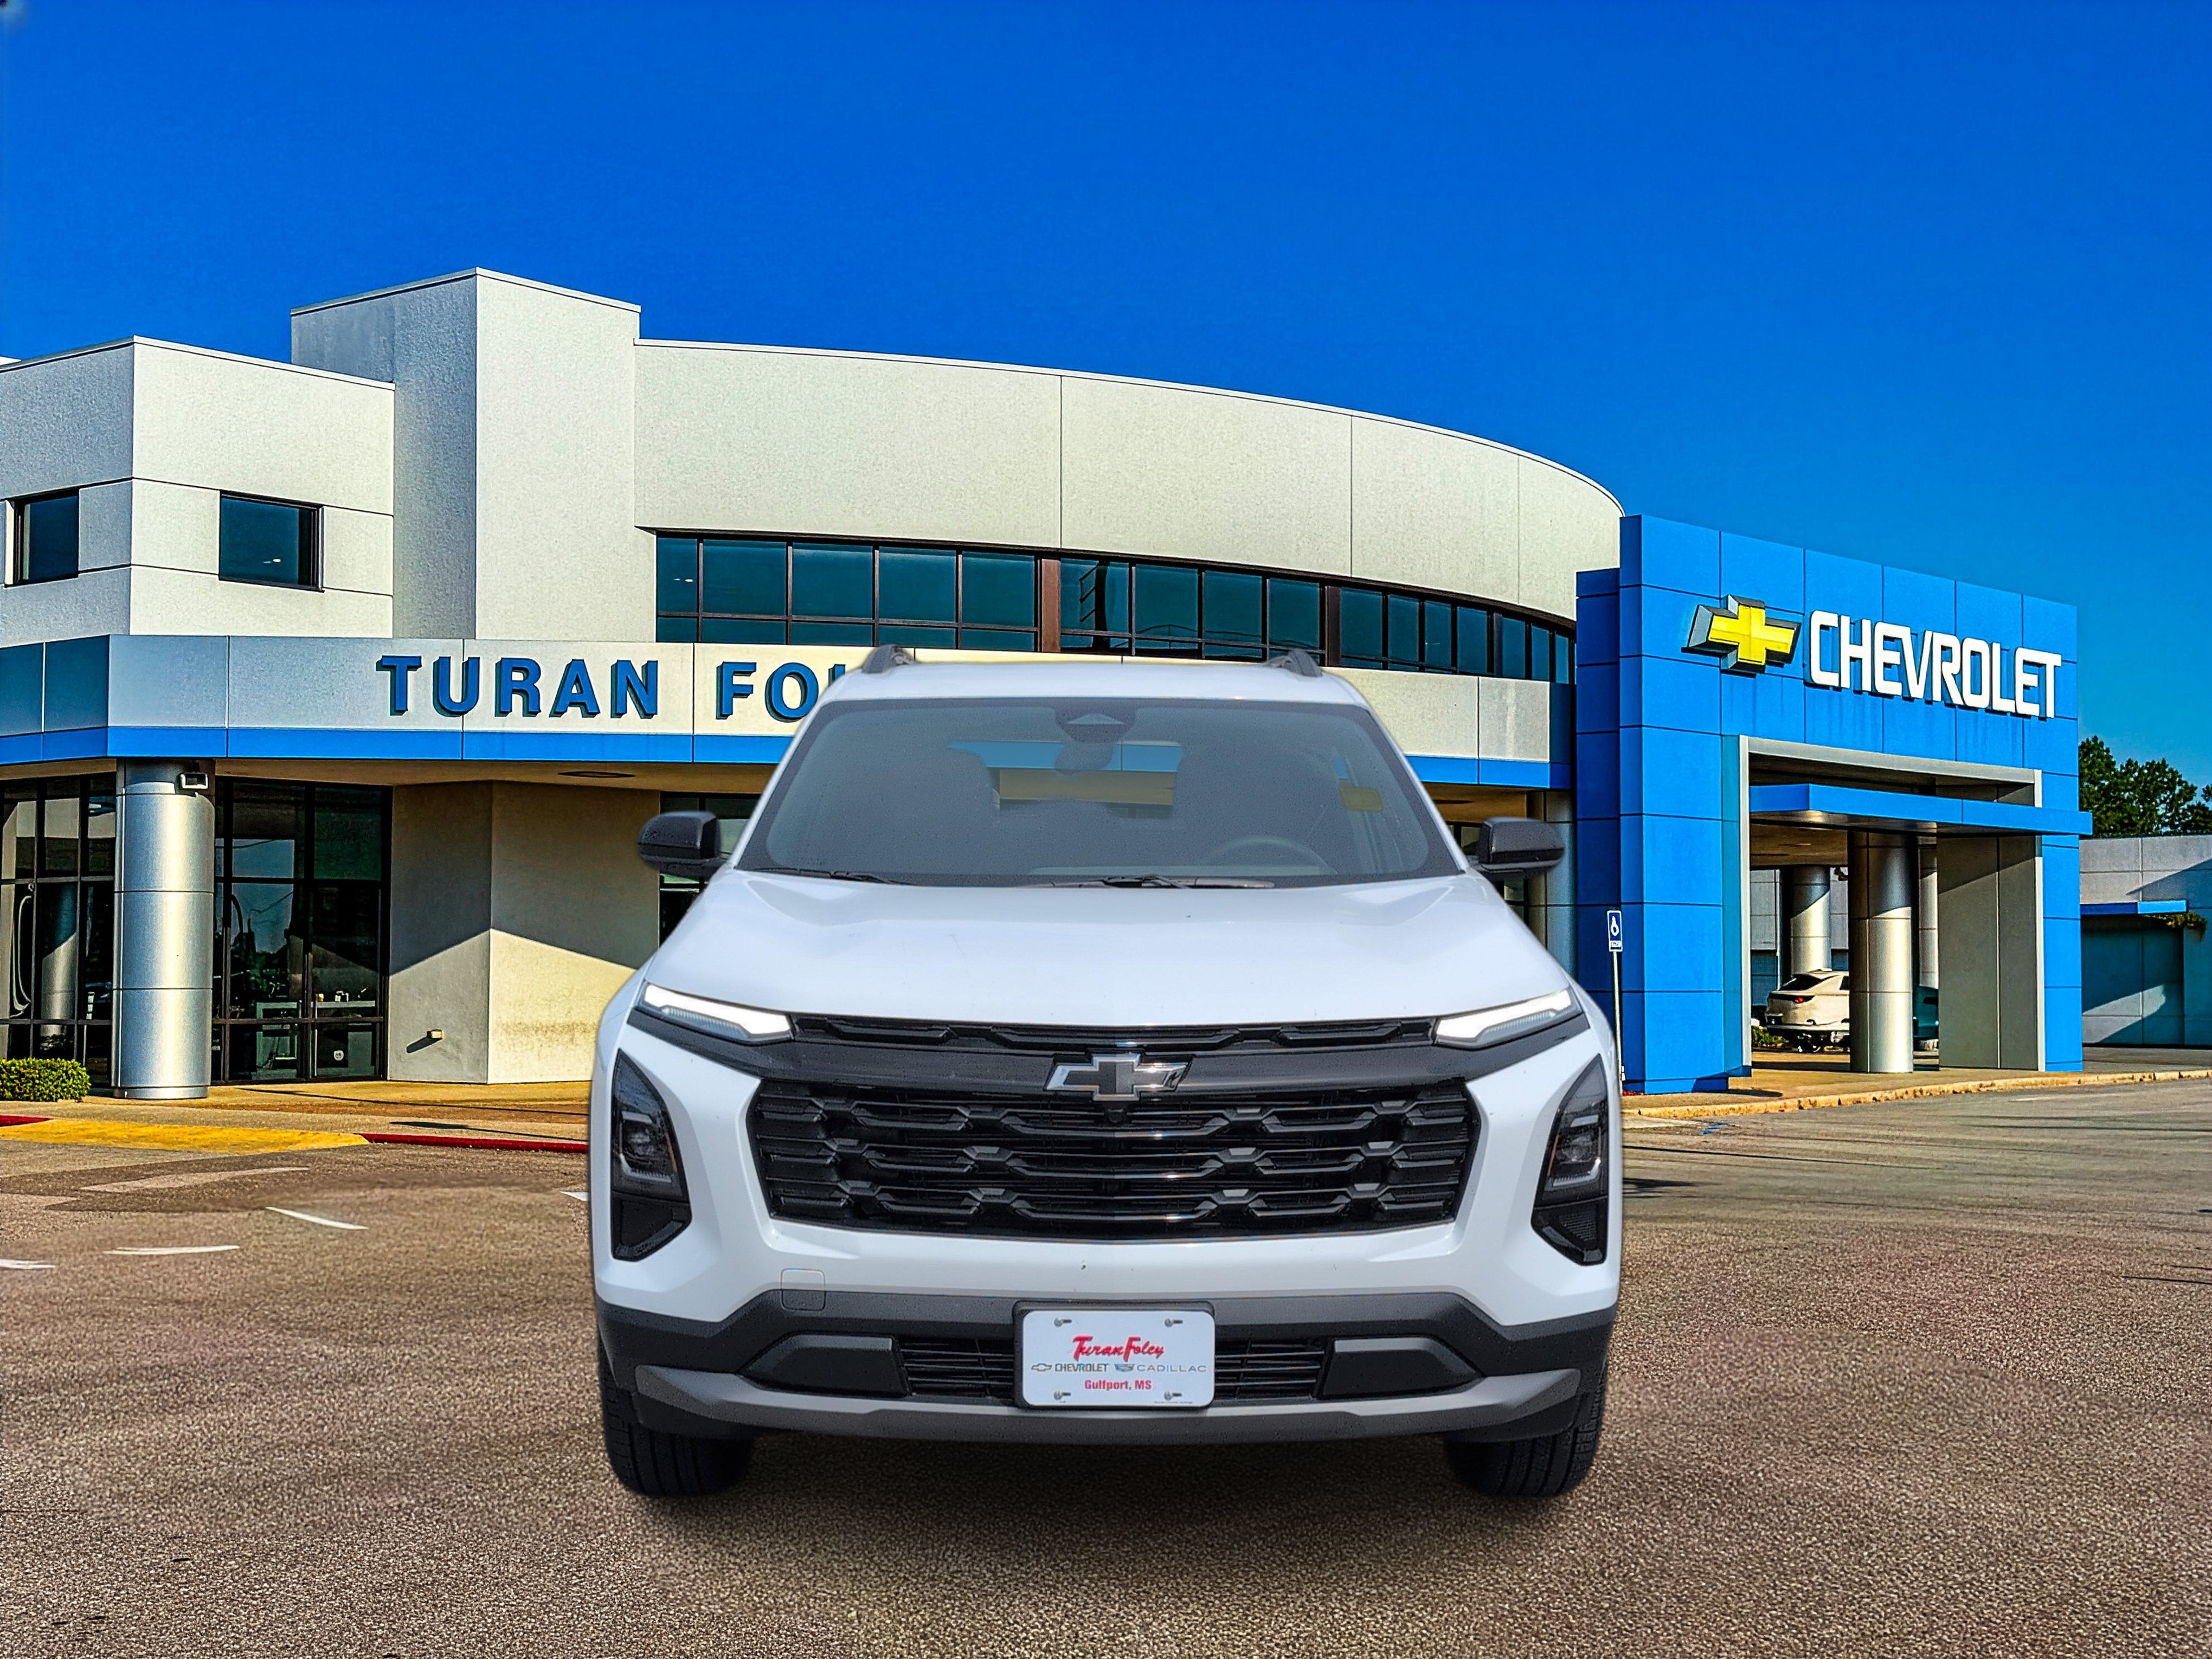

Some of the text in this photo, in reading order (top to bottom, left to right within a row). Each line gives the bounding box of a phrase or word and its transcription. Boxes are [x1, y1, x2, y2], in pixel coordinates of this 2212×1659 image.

[1809, 610, 2062, 719] CHEVROLET
[376, 655, 846, 723] TURAN FO
[1054, 1363, 1206, 1372] CHEVROLET CADILLAC
[1084, 1380, 1152, 1391] Gulfport, MS
